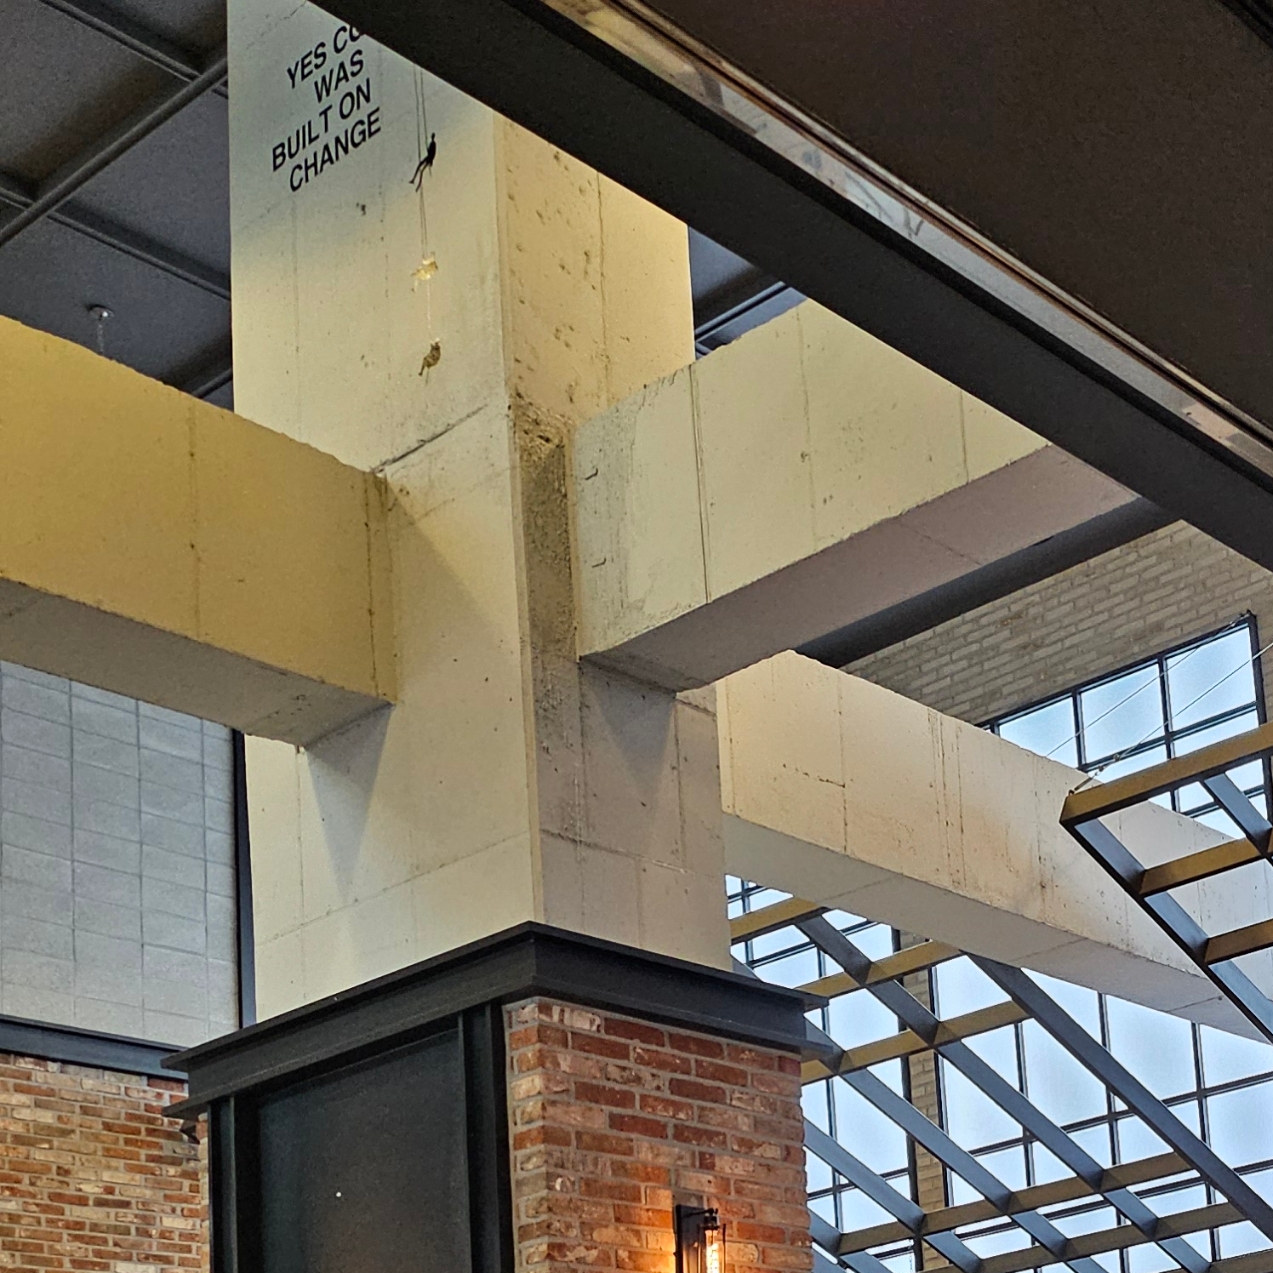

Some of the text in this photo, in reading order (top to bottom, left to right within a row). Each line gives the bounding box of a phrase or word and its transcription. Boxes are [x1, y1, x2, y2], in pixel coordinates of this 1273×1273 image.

[286, 41, 327, 89] YES
[313, 49, 364, 104] WAS
[272, 77, 371, 173] BUILT ON
[289, 106, 382, 192] CHANGE
